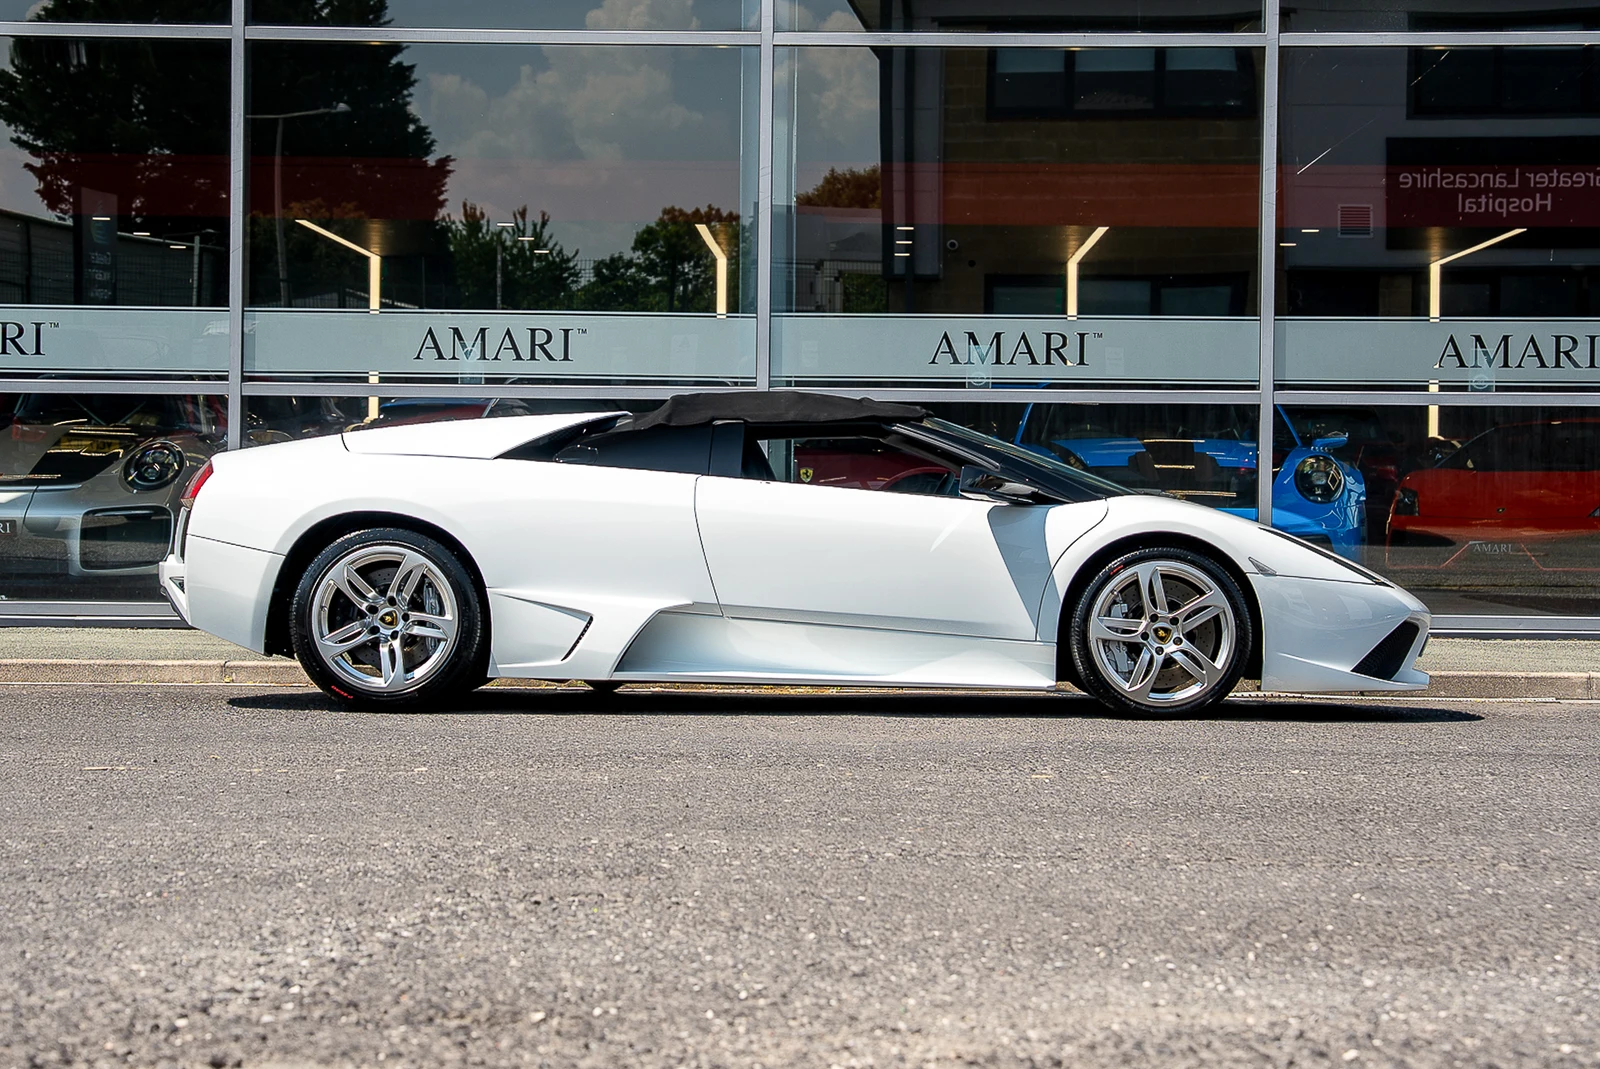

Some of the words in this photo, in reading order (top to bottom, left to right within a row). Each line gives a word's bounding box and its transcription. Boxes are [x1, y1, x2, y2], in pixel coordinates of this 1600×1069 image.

[413, 325, 574, 362] AMARI
[928, 330, 1090, 366] AMARI
[1433, 333, 1600, 369] AMARI
[1473, 543, 1512, 553] AMARI
